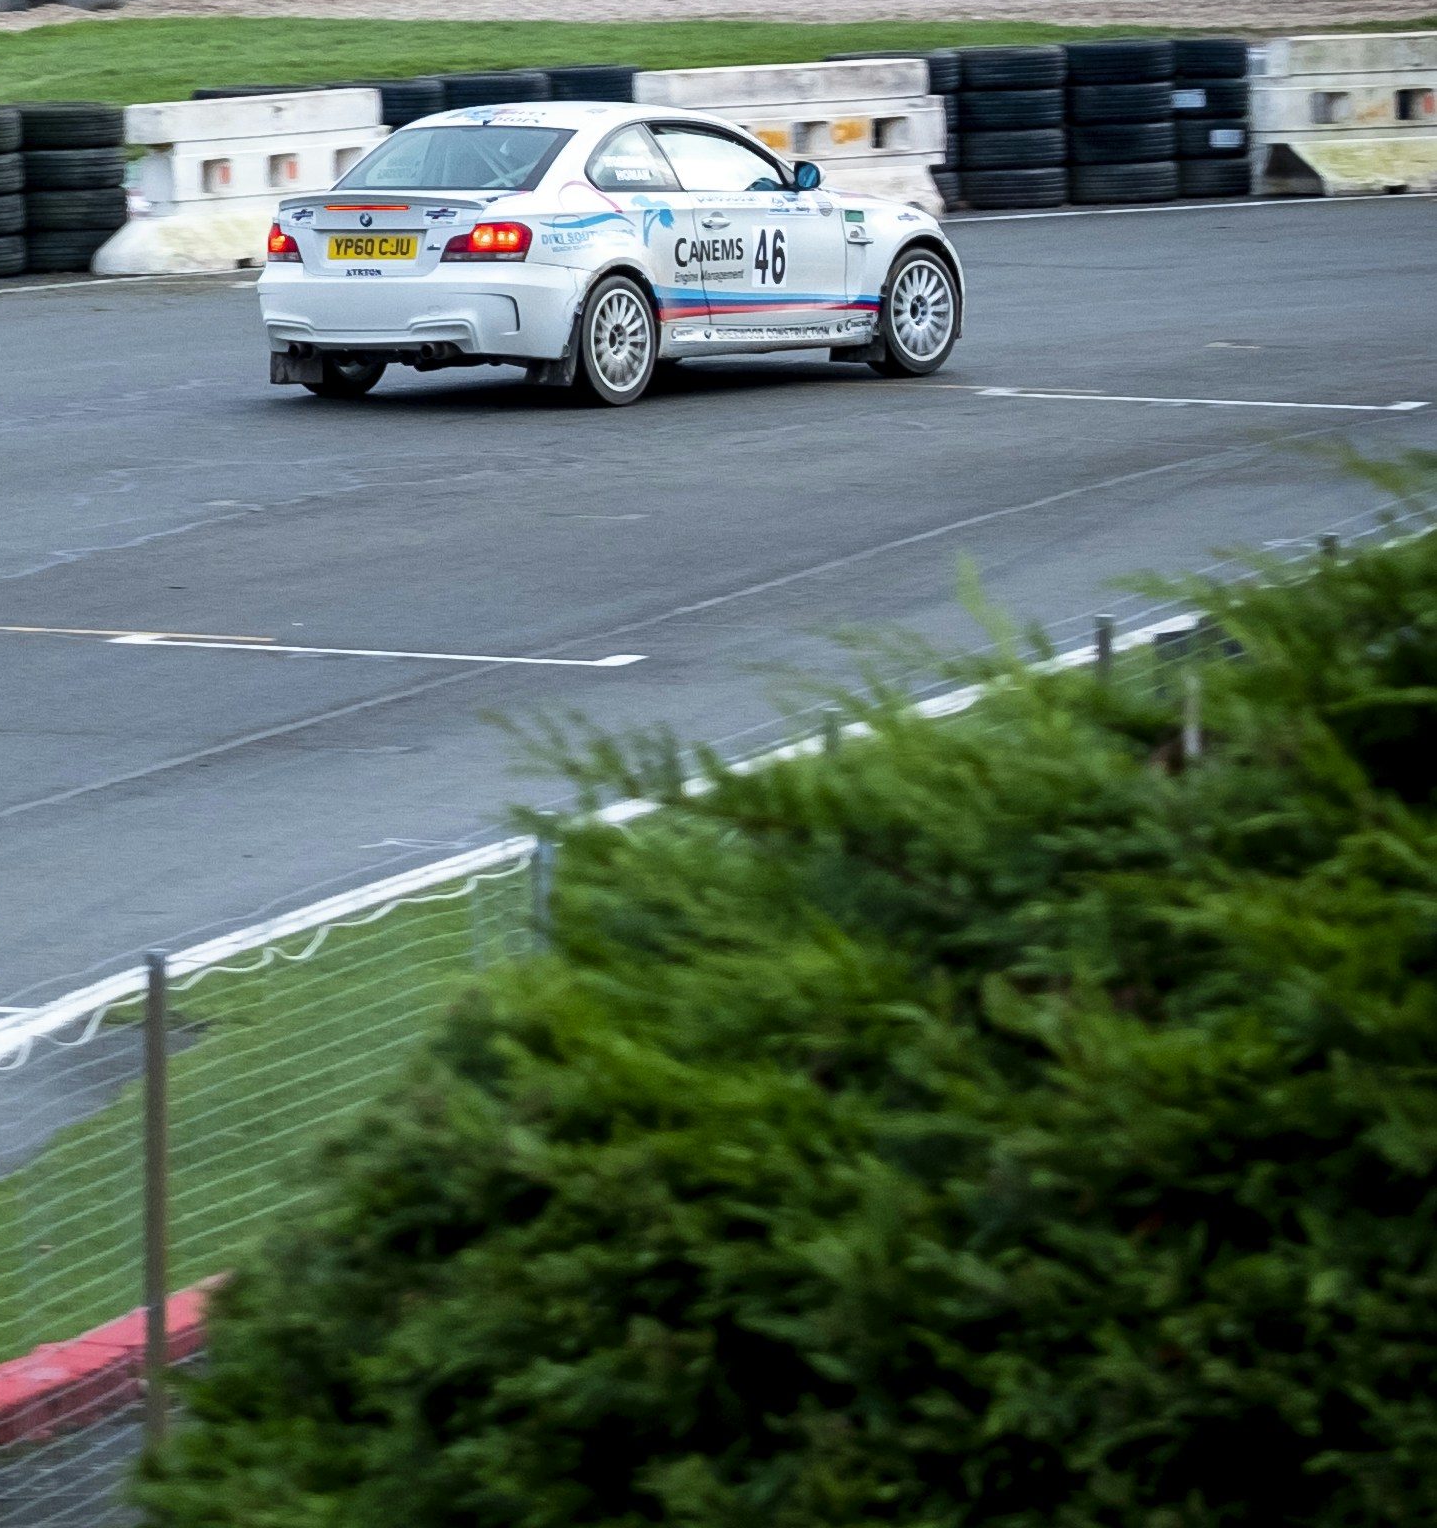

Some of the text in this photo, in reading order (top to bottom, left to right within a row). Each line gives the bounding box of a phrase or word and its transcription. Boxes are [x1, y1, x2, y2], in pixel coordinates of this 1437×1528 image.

[334, 238, 411, 258] YP60 CJU
[675, 237, 744, 267] CANEMS
[755, 229, 786, 284] 46
[675, 269, 744, 285] Engine Management
